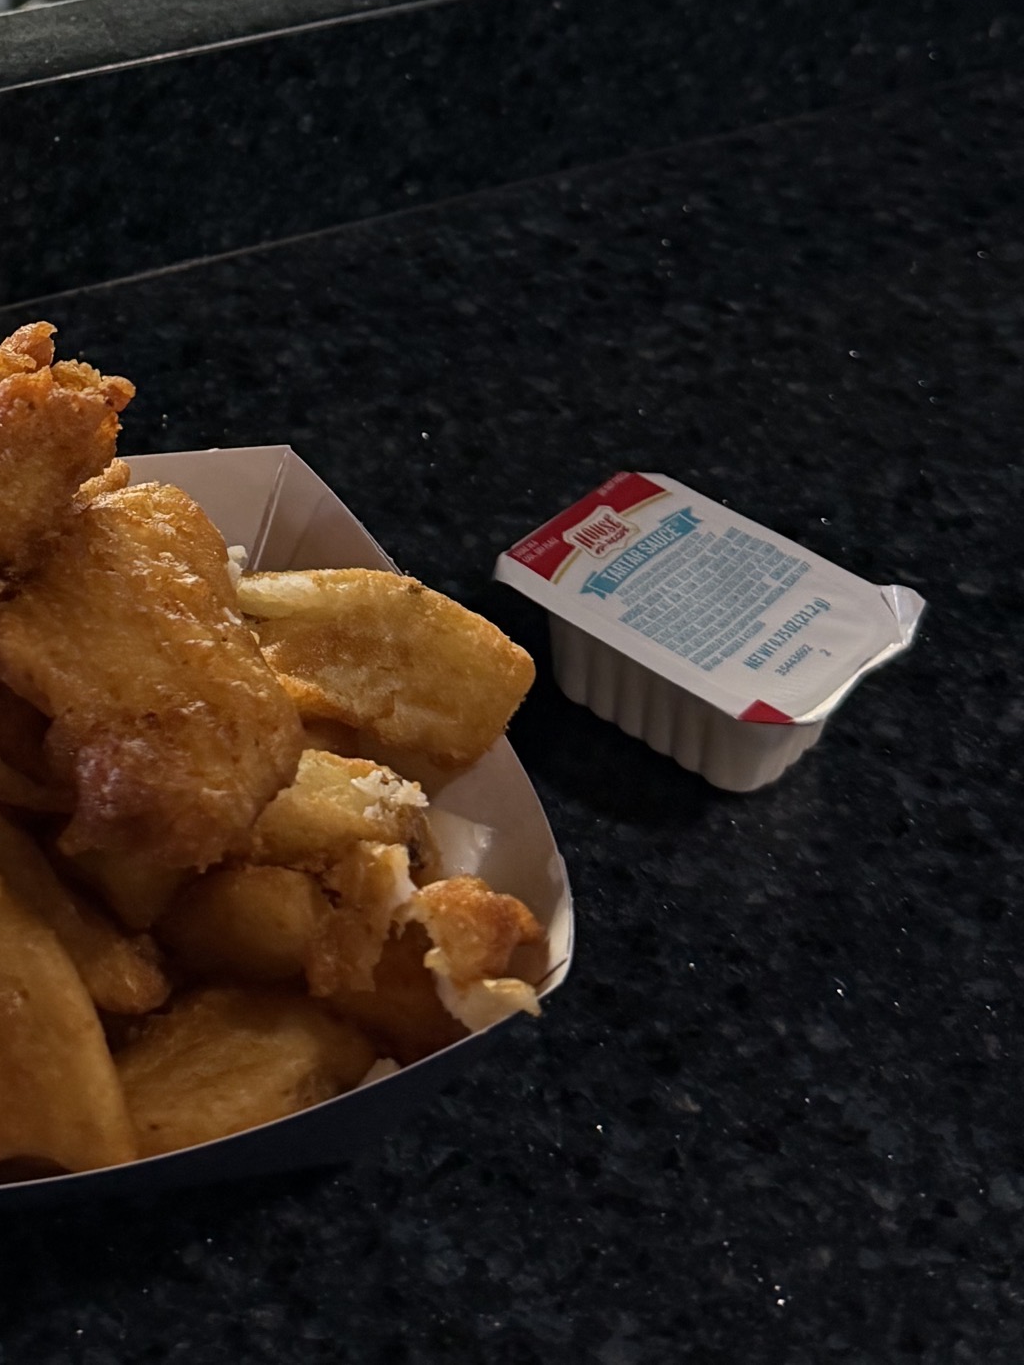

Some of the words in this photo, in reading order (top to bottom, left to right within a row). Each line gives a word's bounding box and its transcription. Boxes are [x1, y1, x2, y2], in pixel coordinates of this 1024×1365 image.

[573, 513, 622, 549] HOUSE
[600, 549, 648, 583] TARTAR
[637, 524, 683, 554] SAUCE
[742, 652, 767, 670] NET
[756, 641, 777, 658] WT
[767, 629, 793, 647] 0.75
[782, 619, 802, 633] OZ
